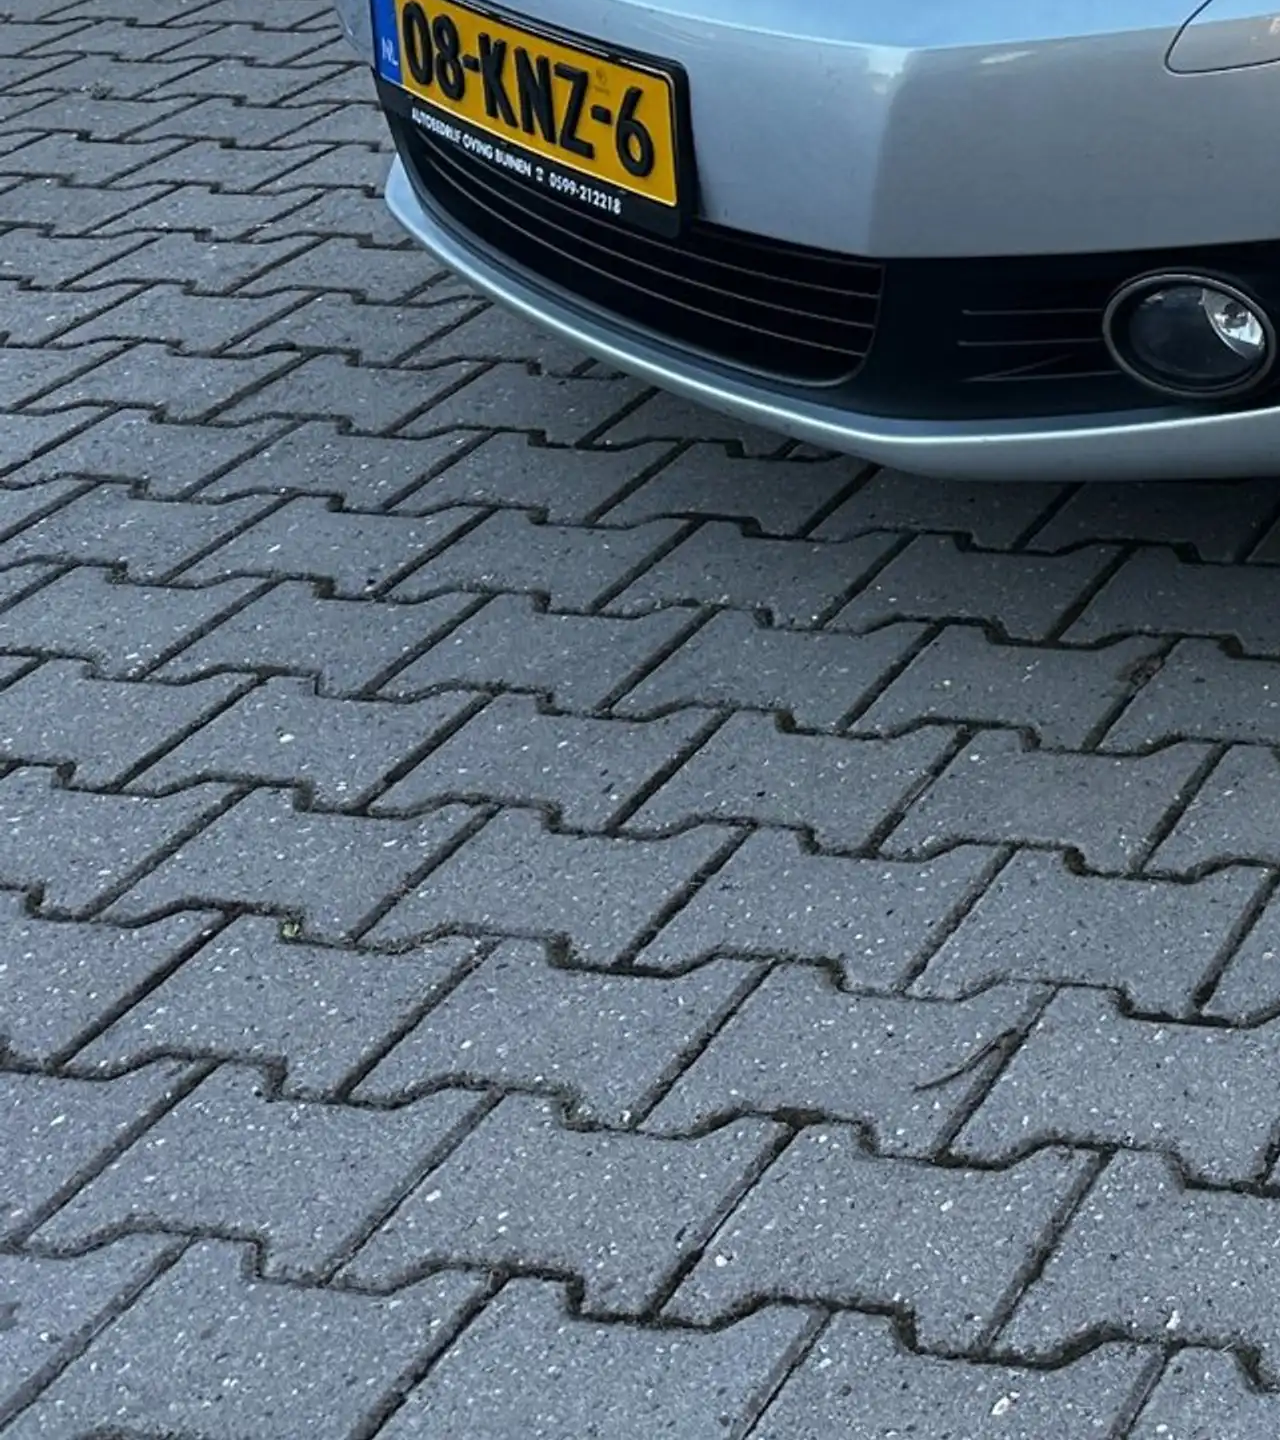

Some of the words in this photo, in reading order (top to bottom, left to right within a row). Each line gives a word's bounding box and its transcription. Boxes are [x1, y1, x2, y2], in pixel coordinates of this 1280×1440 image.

[381, 36, 399, 67] NL
[401, 0, 655, 178] 08-KNZ-6
[462, 134, 493, 160] OVING
[548, 171, 622, 215] 0599-212218
